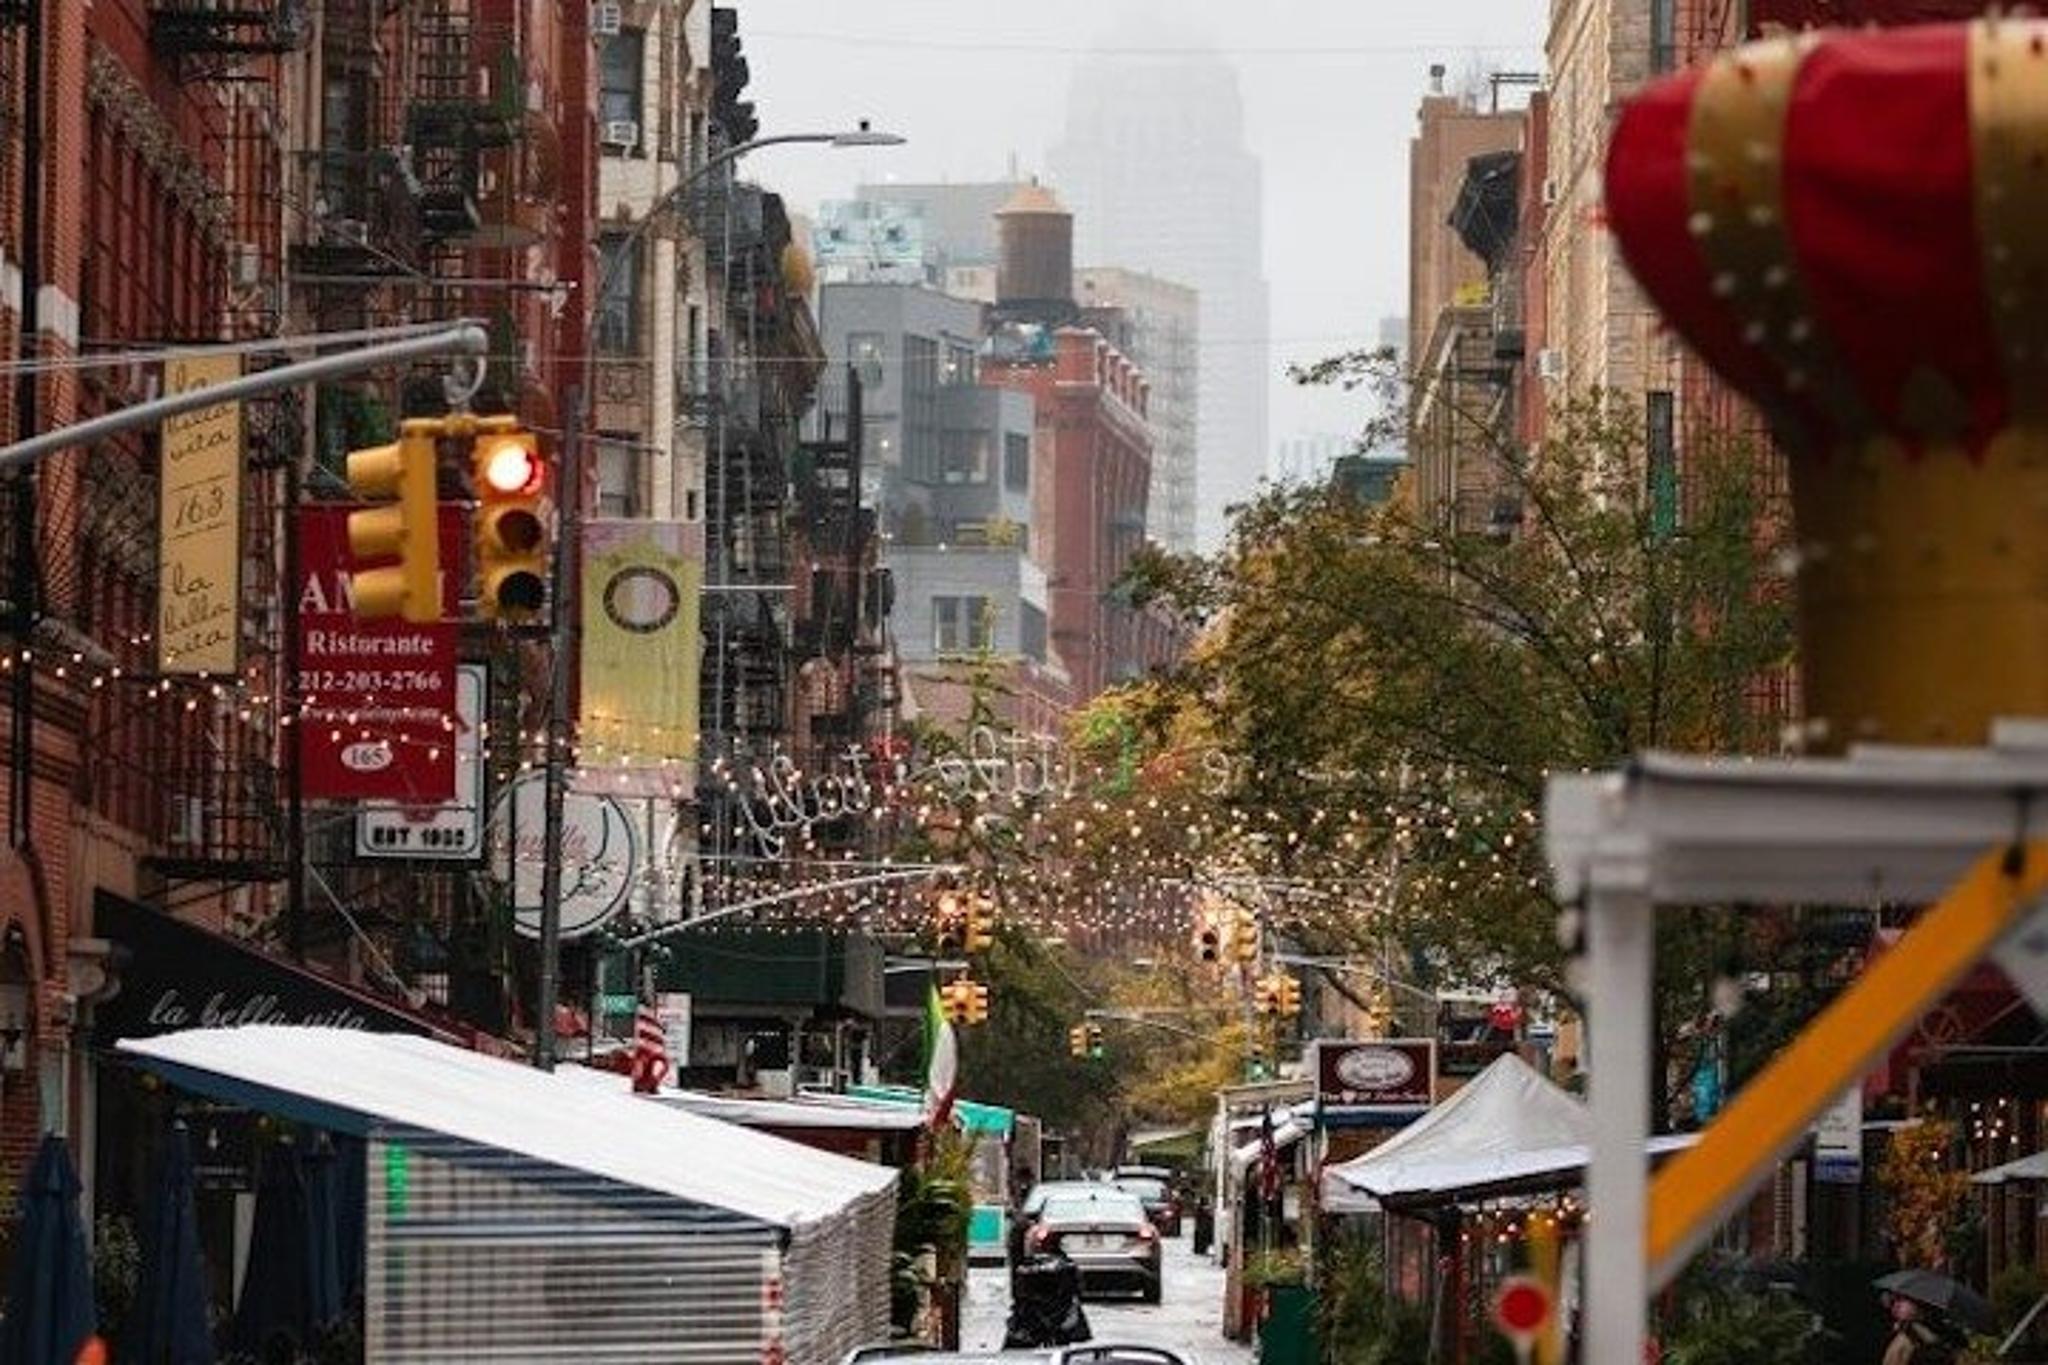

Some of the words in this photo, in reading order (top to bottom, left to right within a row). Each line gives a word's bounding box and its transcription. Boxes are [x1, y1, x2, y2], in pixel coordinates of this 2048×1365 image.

[173, 562, 214, 595] la
[306, 630, 433, 655] Ristorante
[299, 670, 442, 691] 212-203-2766
[148, 988, 190, 1025] la
[199, 991, 292, 1029] bella
[300, 1005, 369, 1030] vita
